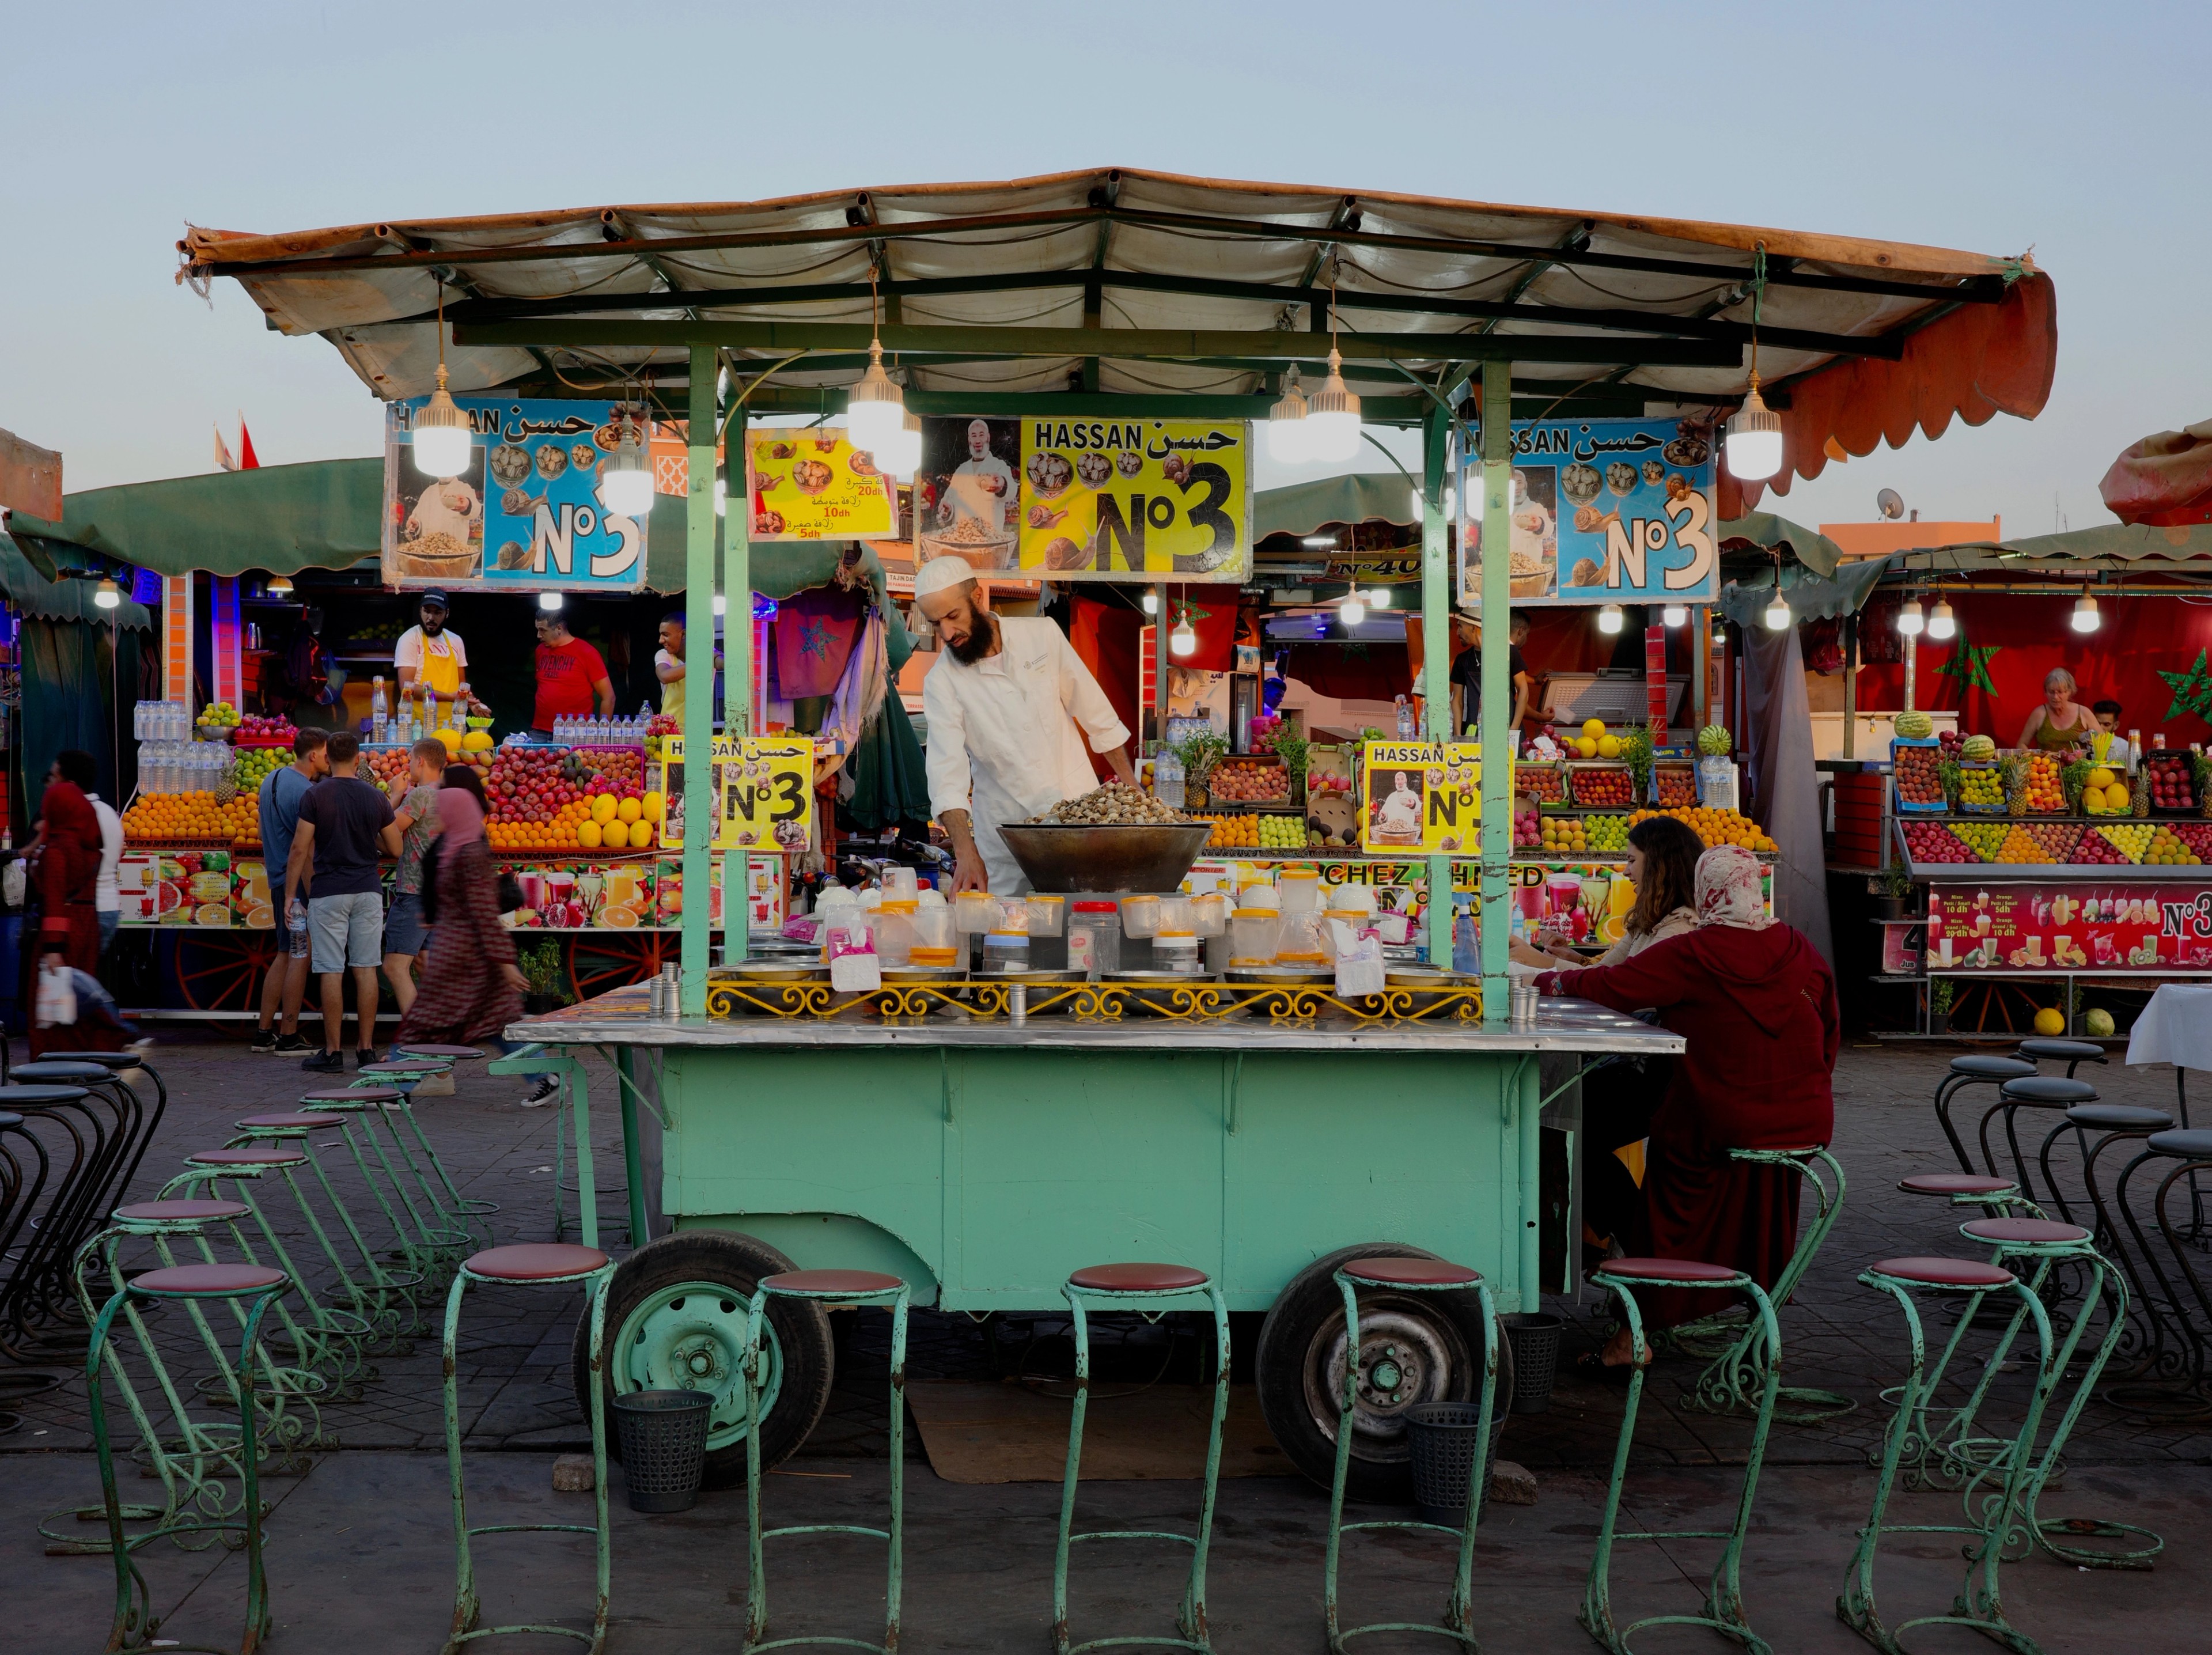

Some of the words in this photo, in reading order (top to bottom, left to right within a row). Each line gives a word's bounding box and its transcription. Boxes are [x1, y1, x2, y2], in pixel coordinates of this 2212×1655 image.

[395, 407, 500, 434] HAN
[503, 405, 596, 444] حسن
[1035, 422, 1142, 450] HASSAN
[1147, 420, 1238, 459] حسن
[1574, 423, 1664, 462] حسن
[858, 486, 883, 496] 20dh
[824, 507, 850, 517] 10dh
[800, 528, 820, 538] 5dh
[745, 740, 806, 762] حسن
[1374, 747, 1444, 763] HASSAN
[1324, 864, 1411, 886] CHEZ
[1900, 959, 1915, 968] Jus
